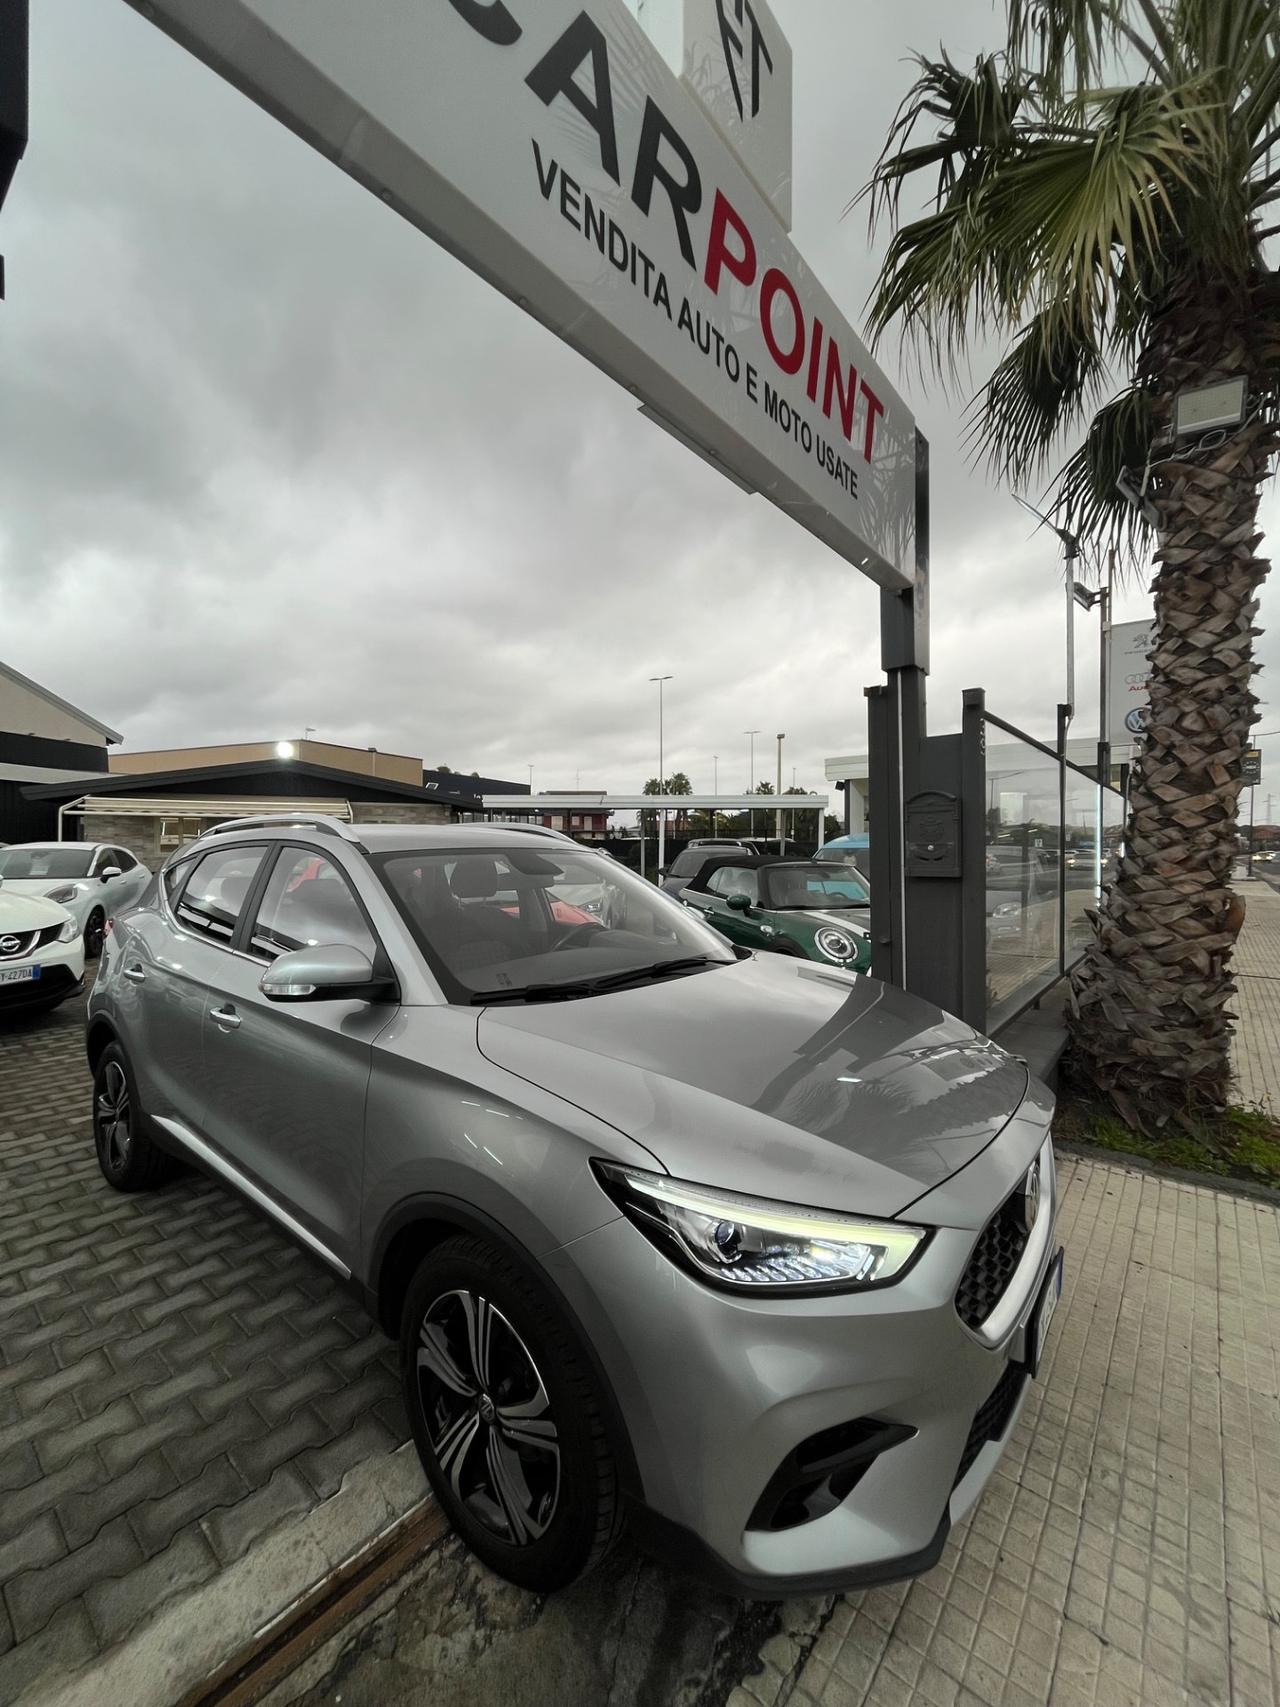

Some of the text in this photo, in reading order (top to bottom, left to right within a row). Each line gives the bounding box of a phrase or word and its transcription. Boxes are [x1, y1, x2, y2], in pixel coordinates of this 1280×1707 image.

[448, 0, 884, 465] ARPOINT
[531, 137, 858, 500] VENDITA AUTO E MOTO USATE
